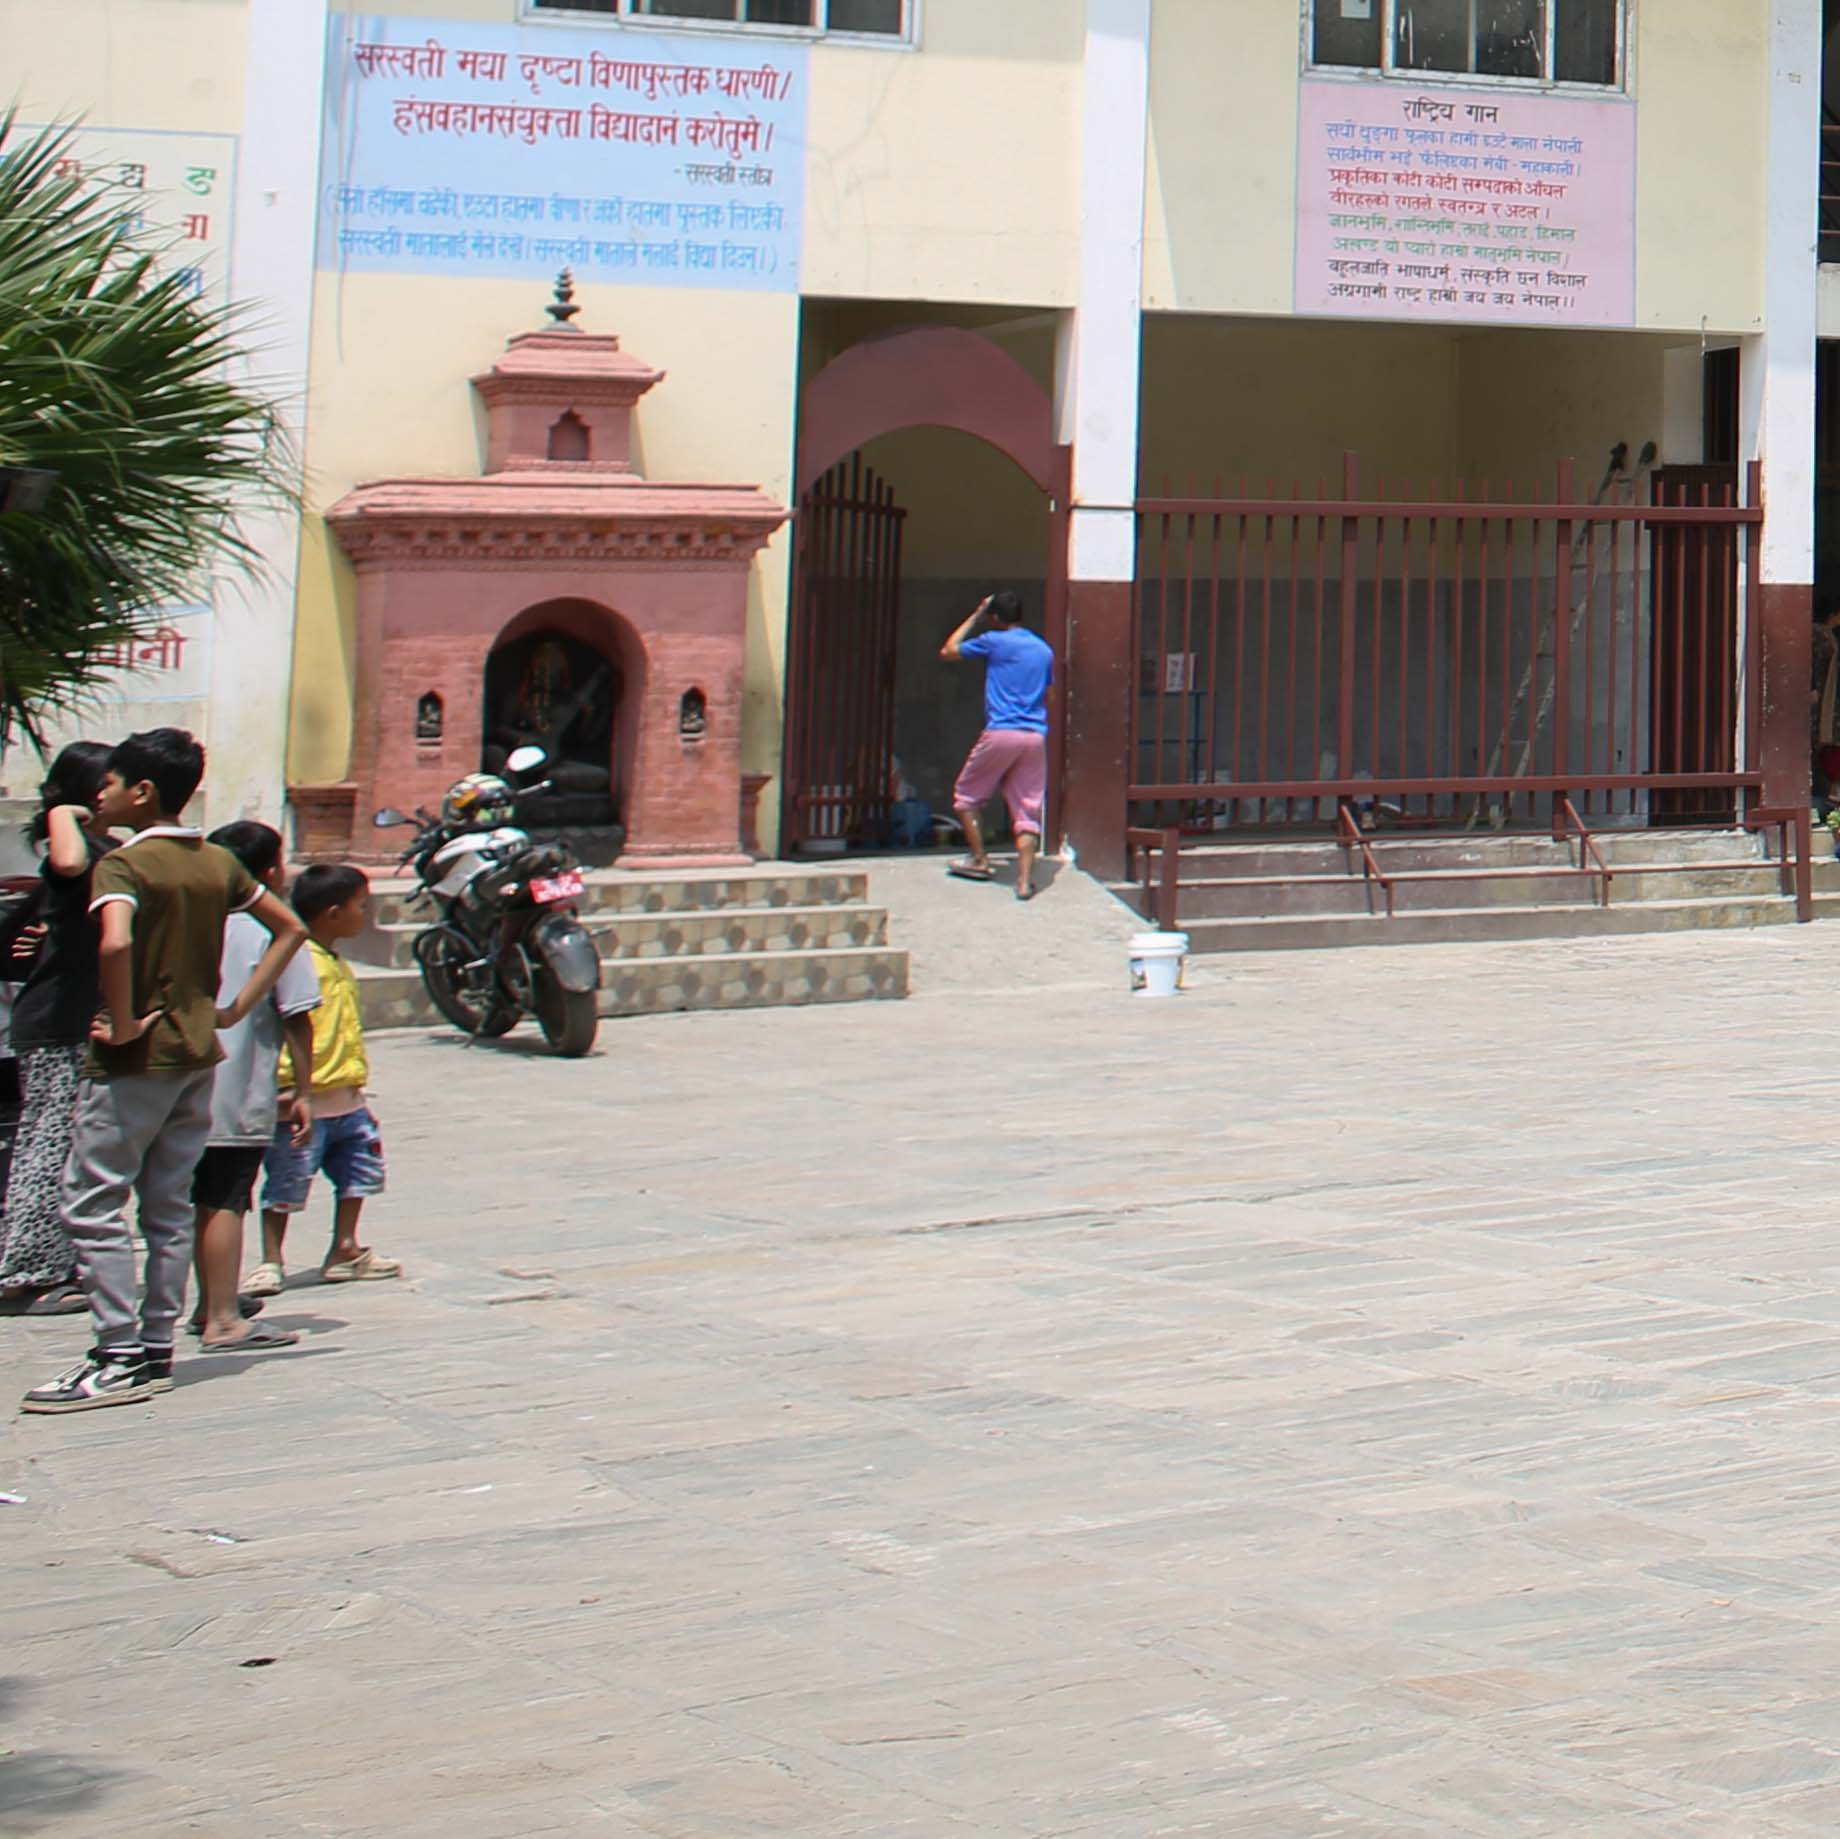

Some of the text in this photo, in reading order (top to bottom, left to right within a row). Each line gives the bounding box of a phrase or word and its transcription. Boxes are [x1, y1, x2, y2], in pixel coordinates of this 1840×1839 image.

[355, 38, 446, 79] सरस्वती
[457, 50, 508, 80] मया
[517, 54, 582, 95] दृष्टा
[588, 50, 711, 100] विणापुस्तक
[1465, 104, 1499, 122] गान
